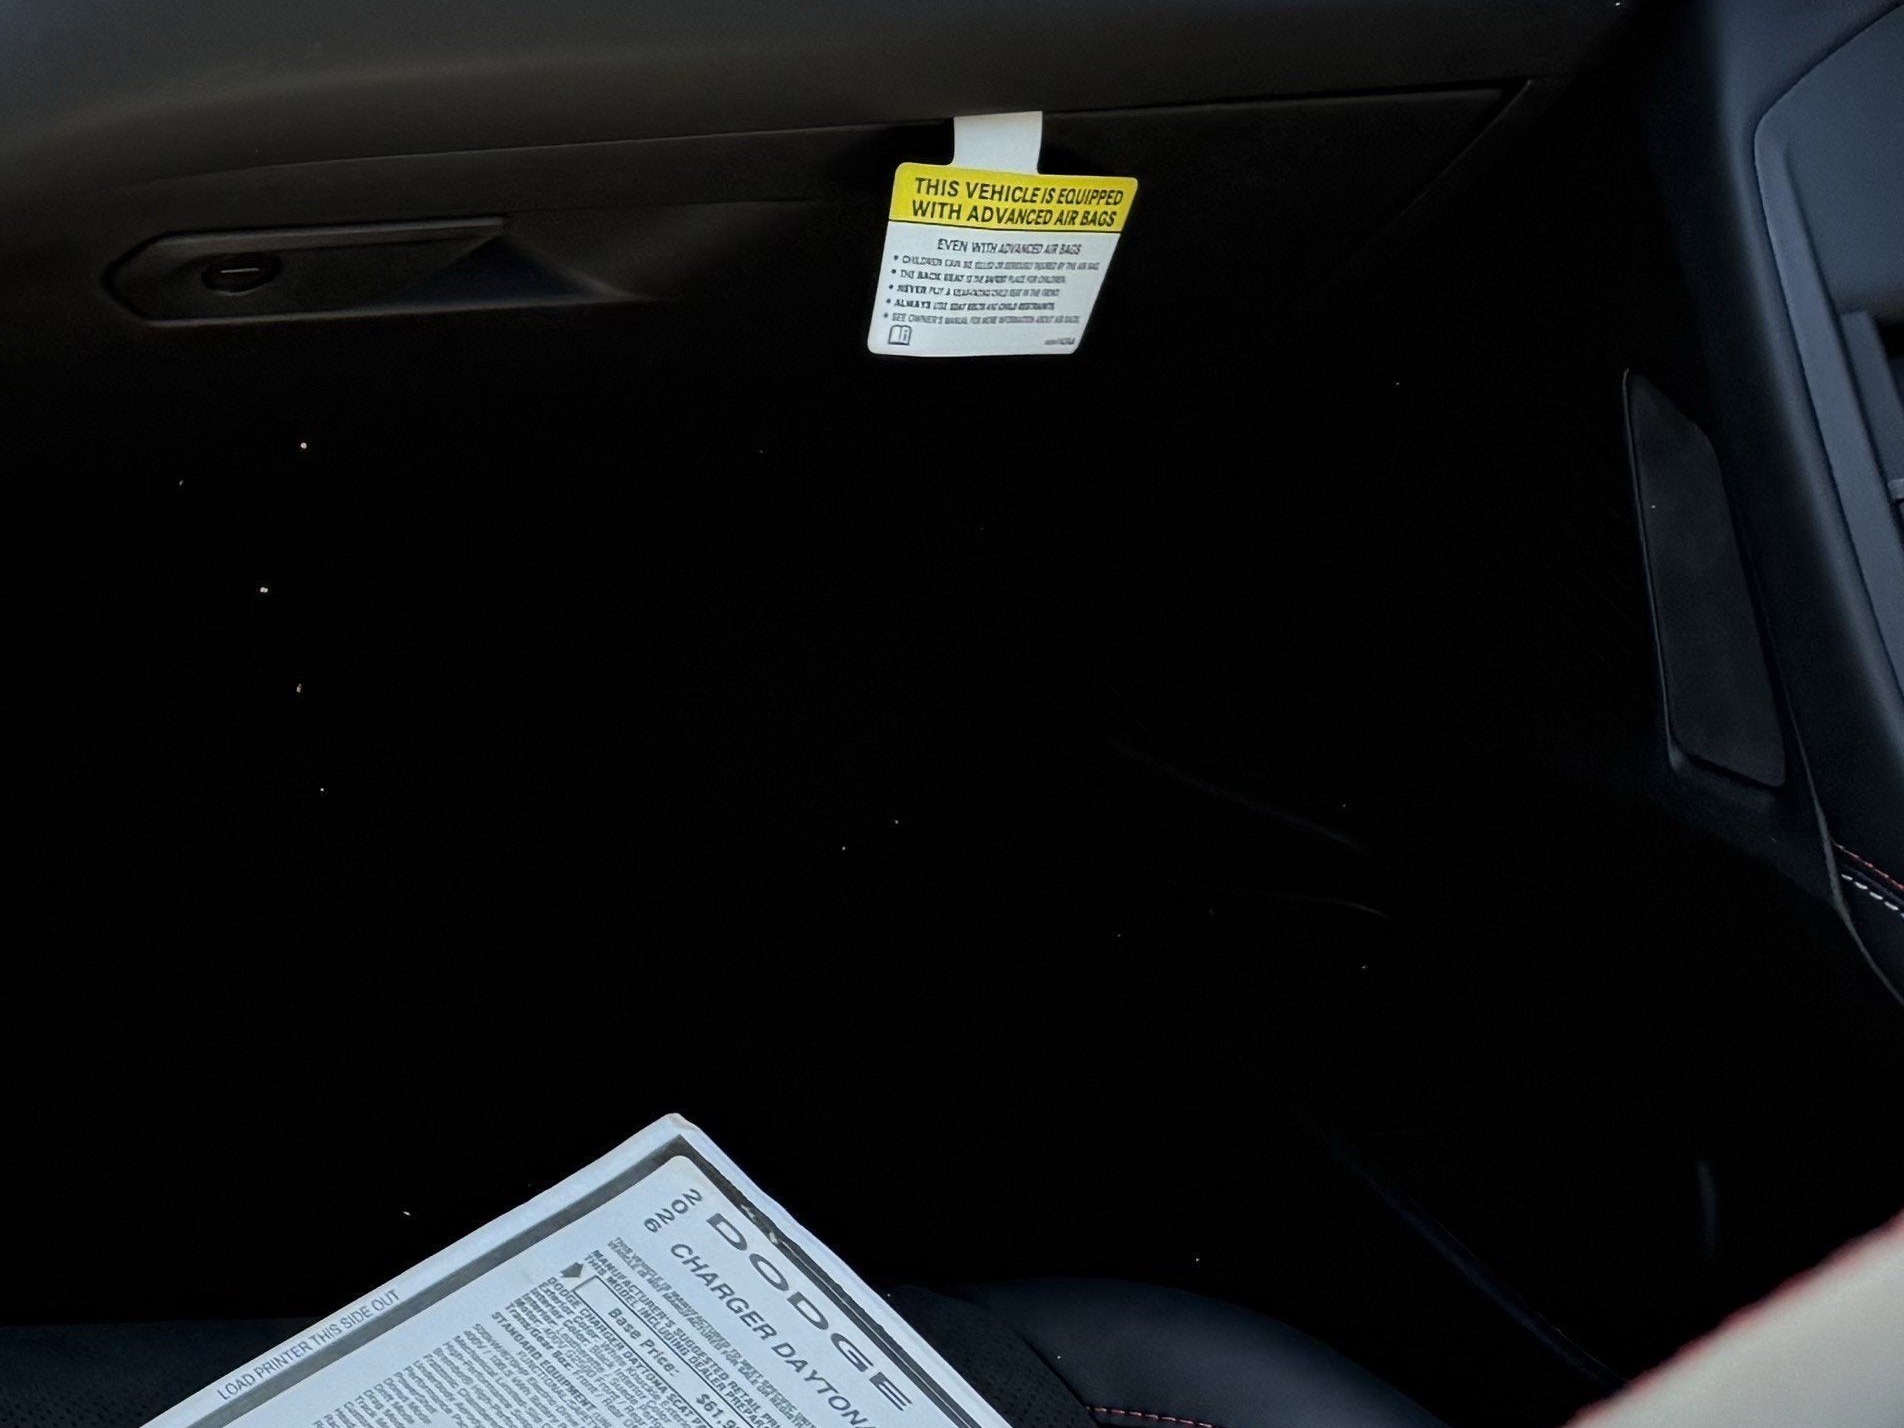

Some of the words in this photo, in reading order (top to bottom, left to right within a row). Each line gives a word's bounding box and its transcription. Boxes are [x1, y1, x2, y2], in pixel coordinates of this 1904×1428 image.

[911, 199, 962, 221] WITH
[967, 203, 1053, 226] ADVANCED
[1055, 209, 1080, 226] AIR
[1079, 210, 1117, 227] BAGS
[914, 177, 960, 198] THIS
[966, 181, 1041, 203] VEHICLE
[1041, 187, 1055, 204] IS
[1056, 188, 1124, 206] EQUIPPED
[937, 238, 968, 252] EVEN
[971, 240, 997, 253] WITH
[998, 243, 1042, 255] ADVANCED
[1044, 243, 1058, 255] AIR
[670, 1243, 776, 1339] CHARGER
[707, 1213, 910, 1409] DODGE
[216, 1372, 256, 1401] LOAD
[256, 1340, 313, 1380] PRINTER
[310, 1323, 343, 1346] THIS
[341, 1305, 373, 1330] SIDE
[370, 1288, 400, 1312] OUT
[607, 1307, 641, 1339] Base
[639, 1338, 679, 1376] Price:
